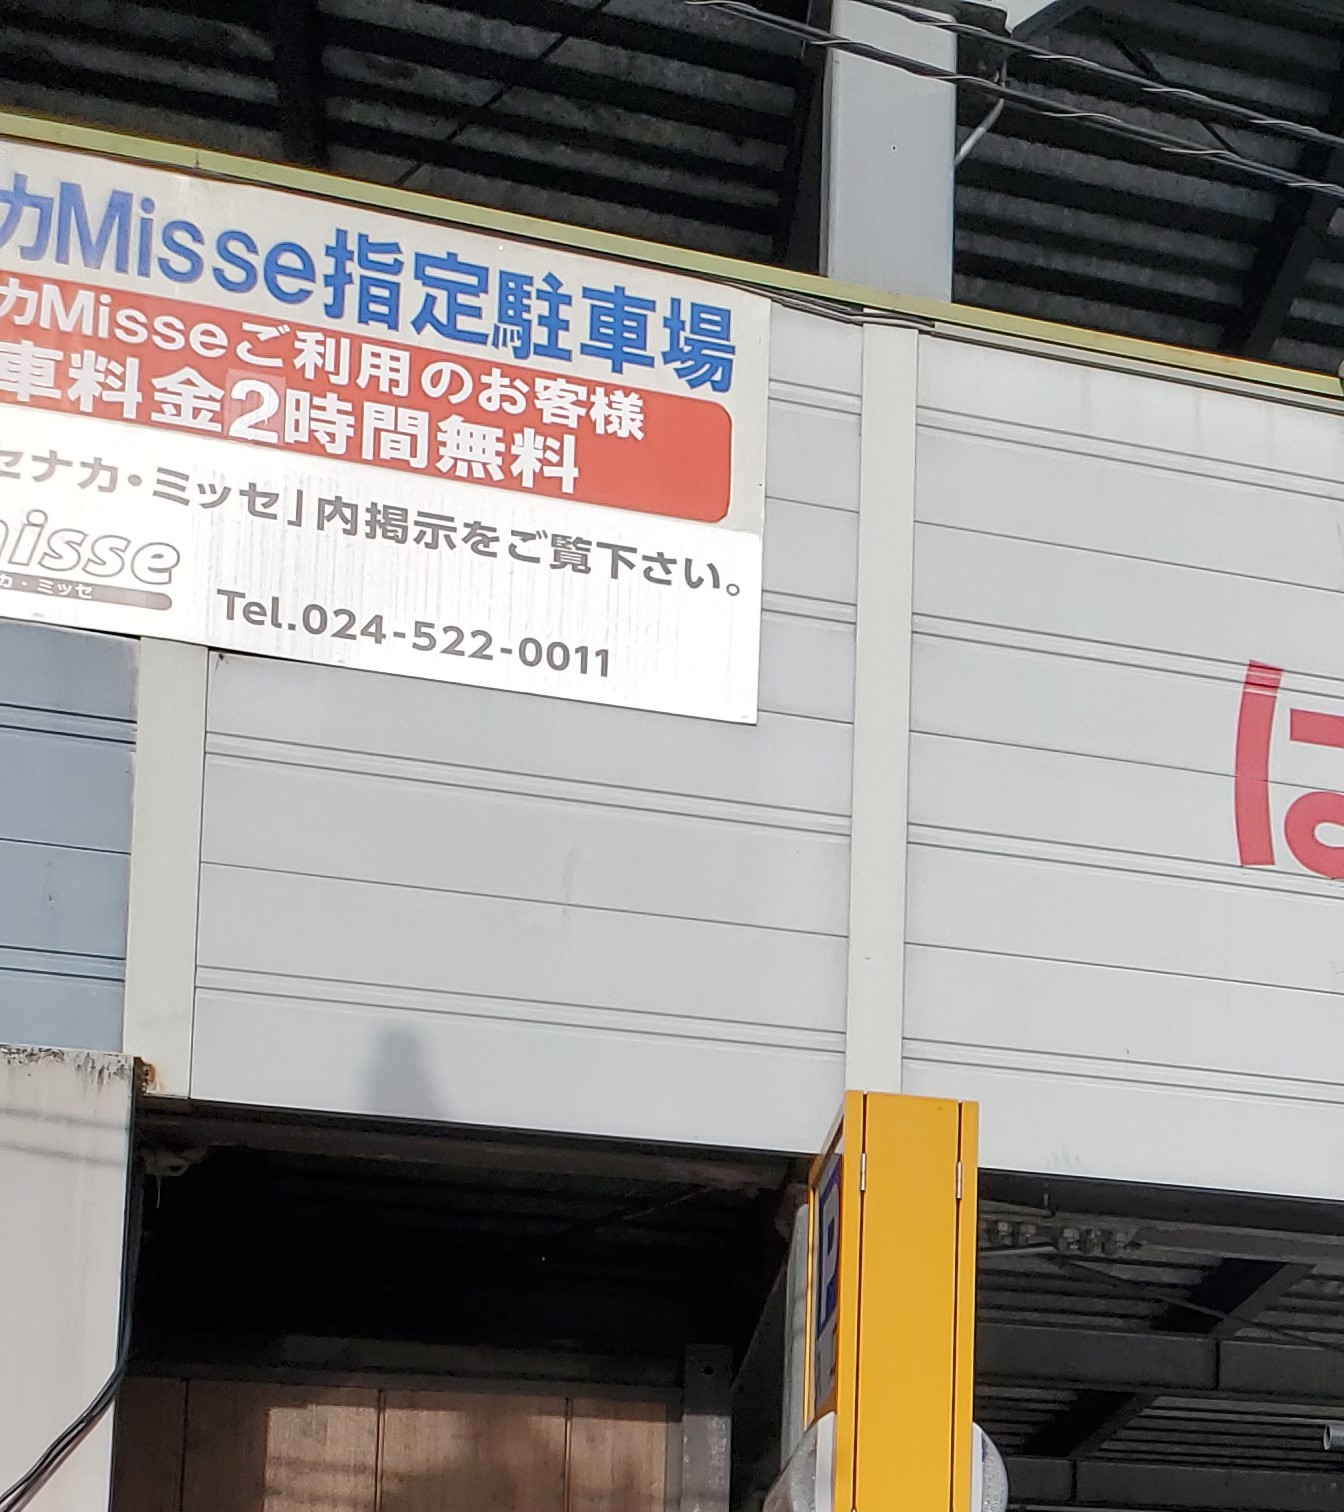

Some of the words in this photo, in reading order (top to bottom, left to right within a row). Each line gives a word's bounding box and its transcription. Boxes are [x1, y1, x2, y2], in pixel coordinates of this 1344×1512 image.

[0, 172, 737, 393] カMisse指定駐車場
[0, 277, 645, 442] カMisseご利用のお客様
[0, 340, 580, 494] 車料金2時間無料
[216, 588, 611, 678] Tel.024-522-0011
